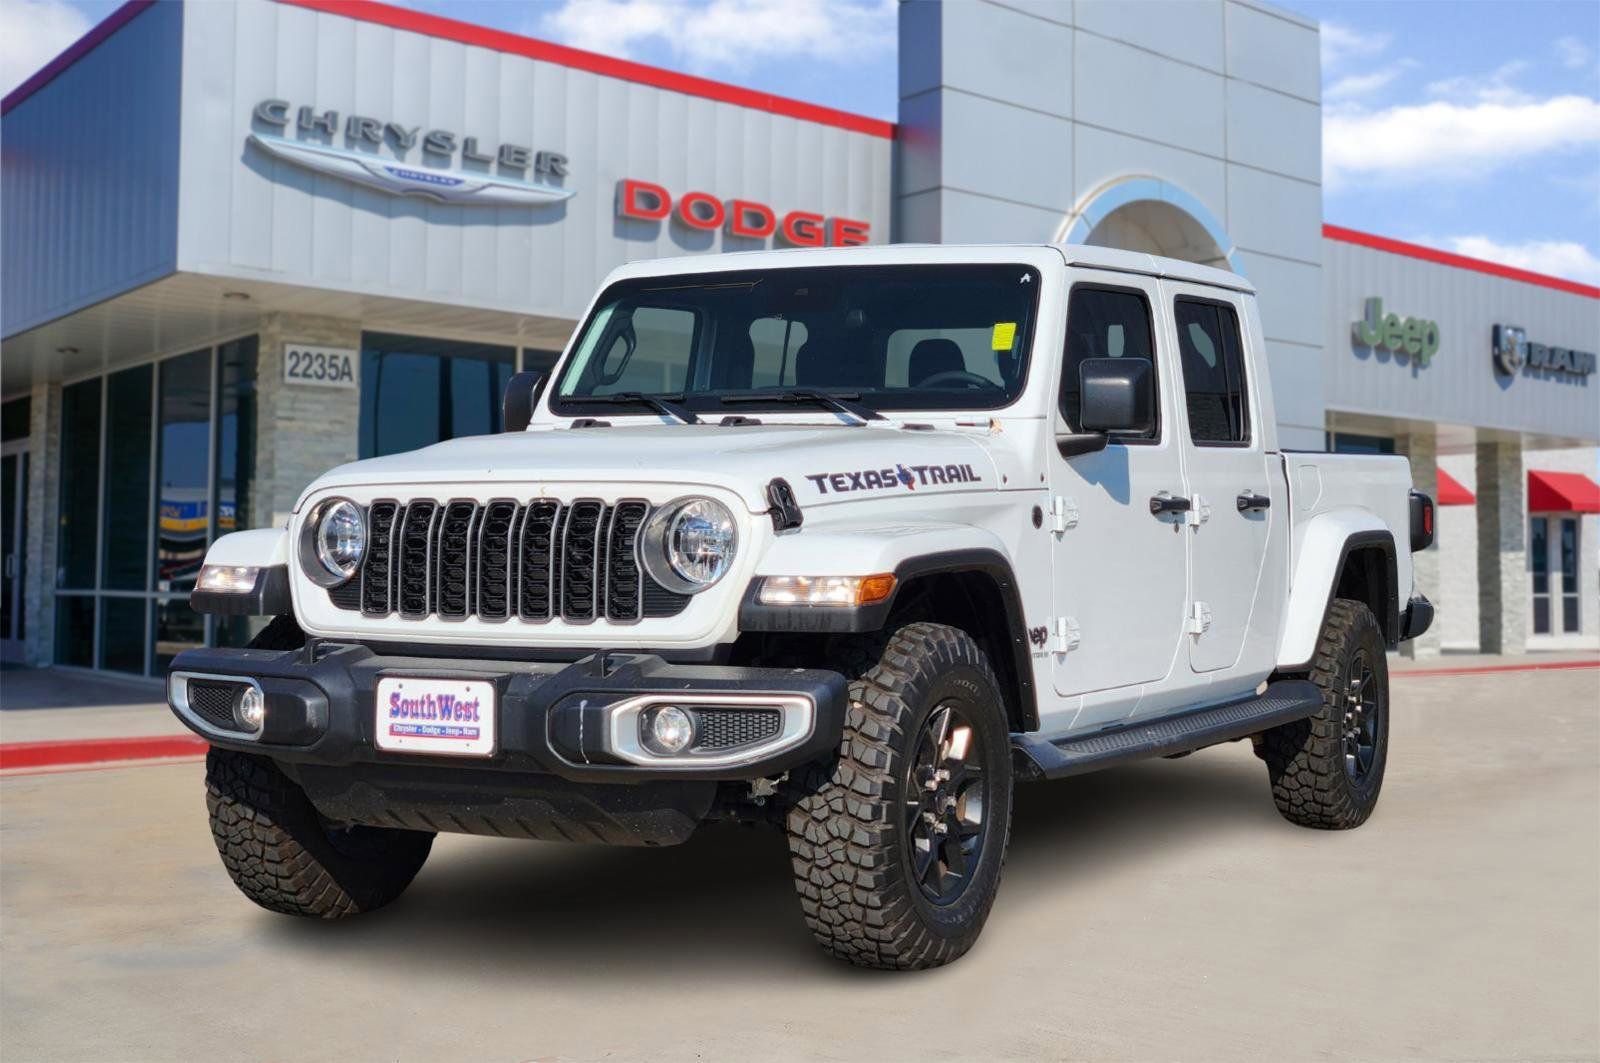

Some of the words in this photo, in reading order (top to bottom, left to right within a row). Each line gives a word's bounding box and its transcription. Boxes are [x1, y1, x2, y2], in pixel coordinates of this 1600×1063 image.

[252, 98, 569, 177] CHRYSLER
[618, 178, 871, 248] DODGE
[1352, 297, 1440, 366] Jeep
[288, 350, 353, 382] 2235A
[1526, 341, 1597, 375] RAM
[804, 469, 899, 495] TEXAS
[909, 463, 982, 486] TRAIL
[389, 692, 480, 721] SouthWest
